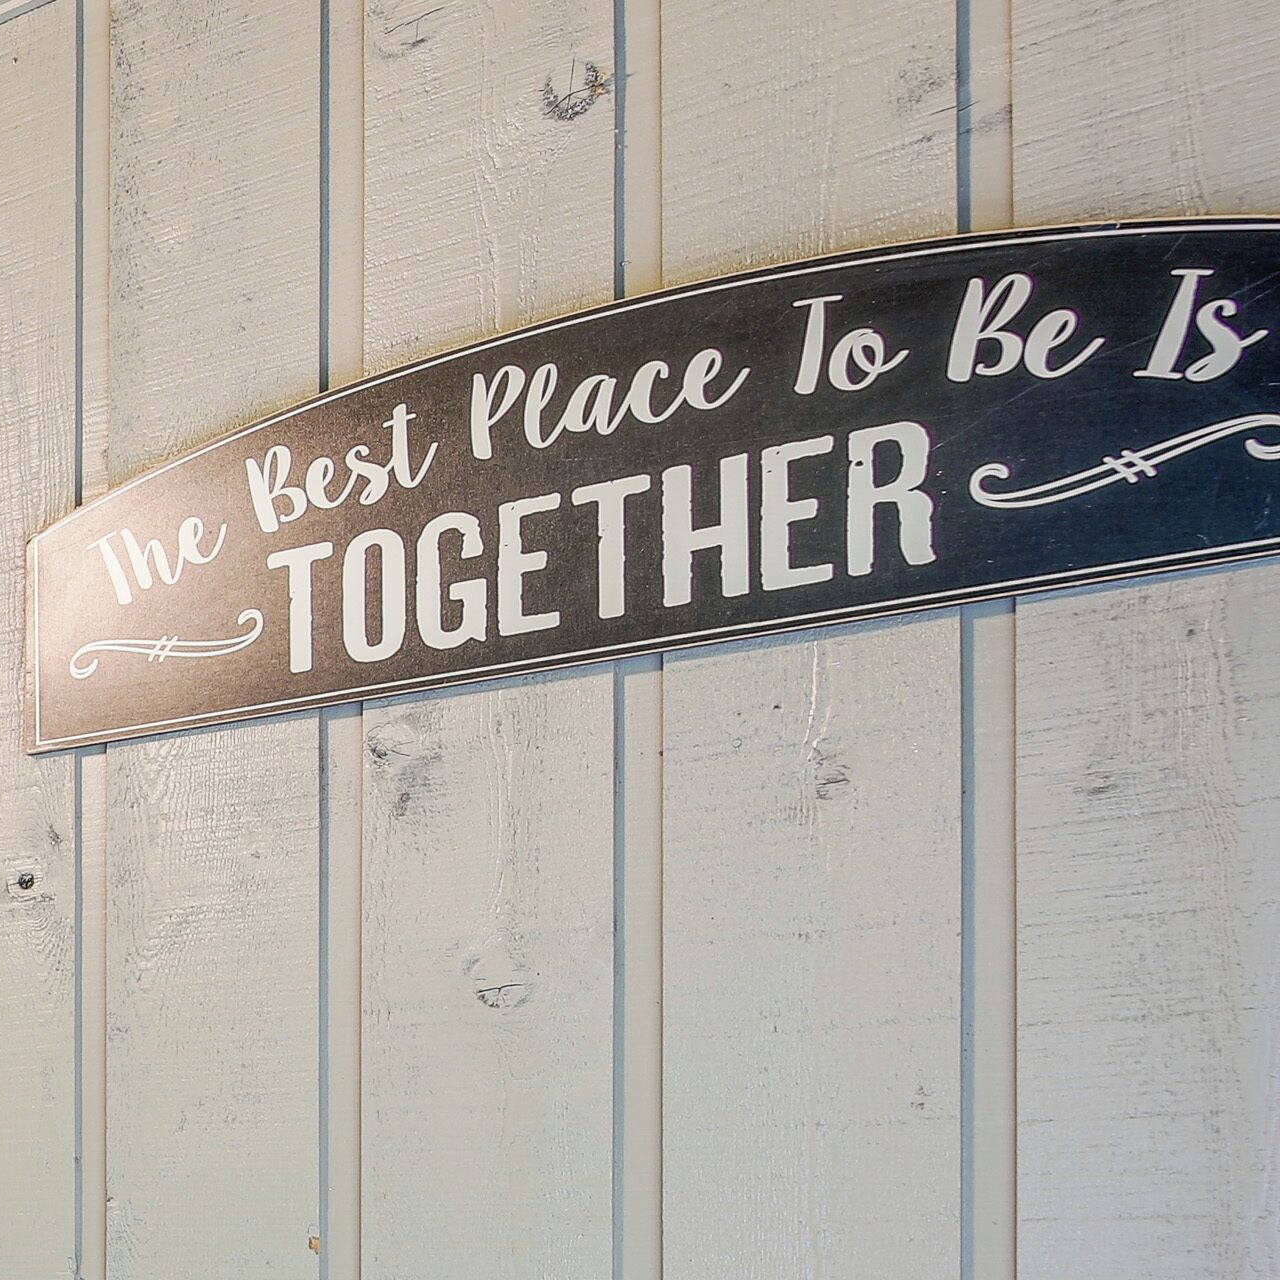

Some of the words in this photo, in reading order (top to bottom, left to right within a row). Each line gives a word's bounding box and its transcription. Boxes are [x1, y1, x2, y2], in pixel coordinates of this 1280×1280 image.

[87, 516, 228, 606] The
[244, 402, 439, 533] Best
[470, 347, 751, 461] Place
[792, 293, 910, 395] To
[945, 272, 1105, 383] Be
[1132, 267, 1269, 382] Is
[266, 421, 937, 674] TOGETHER
